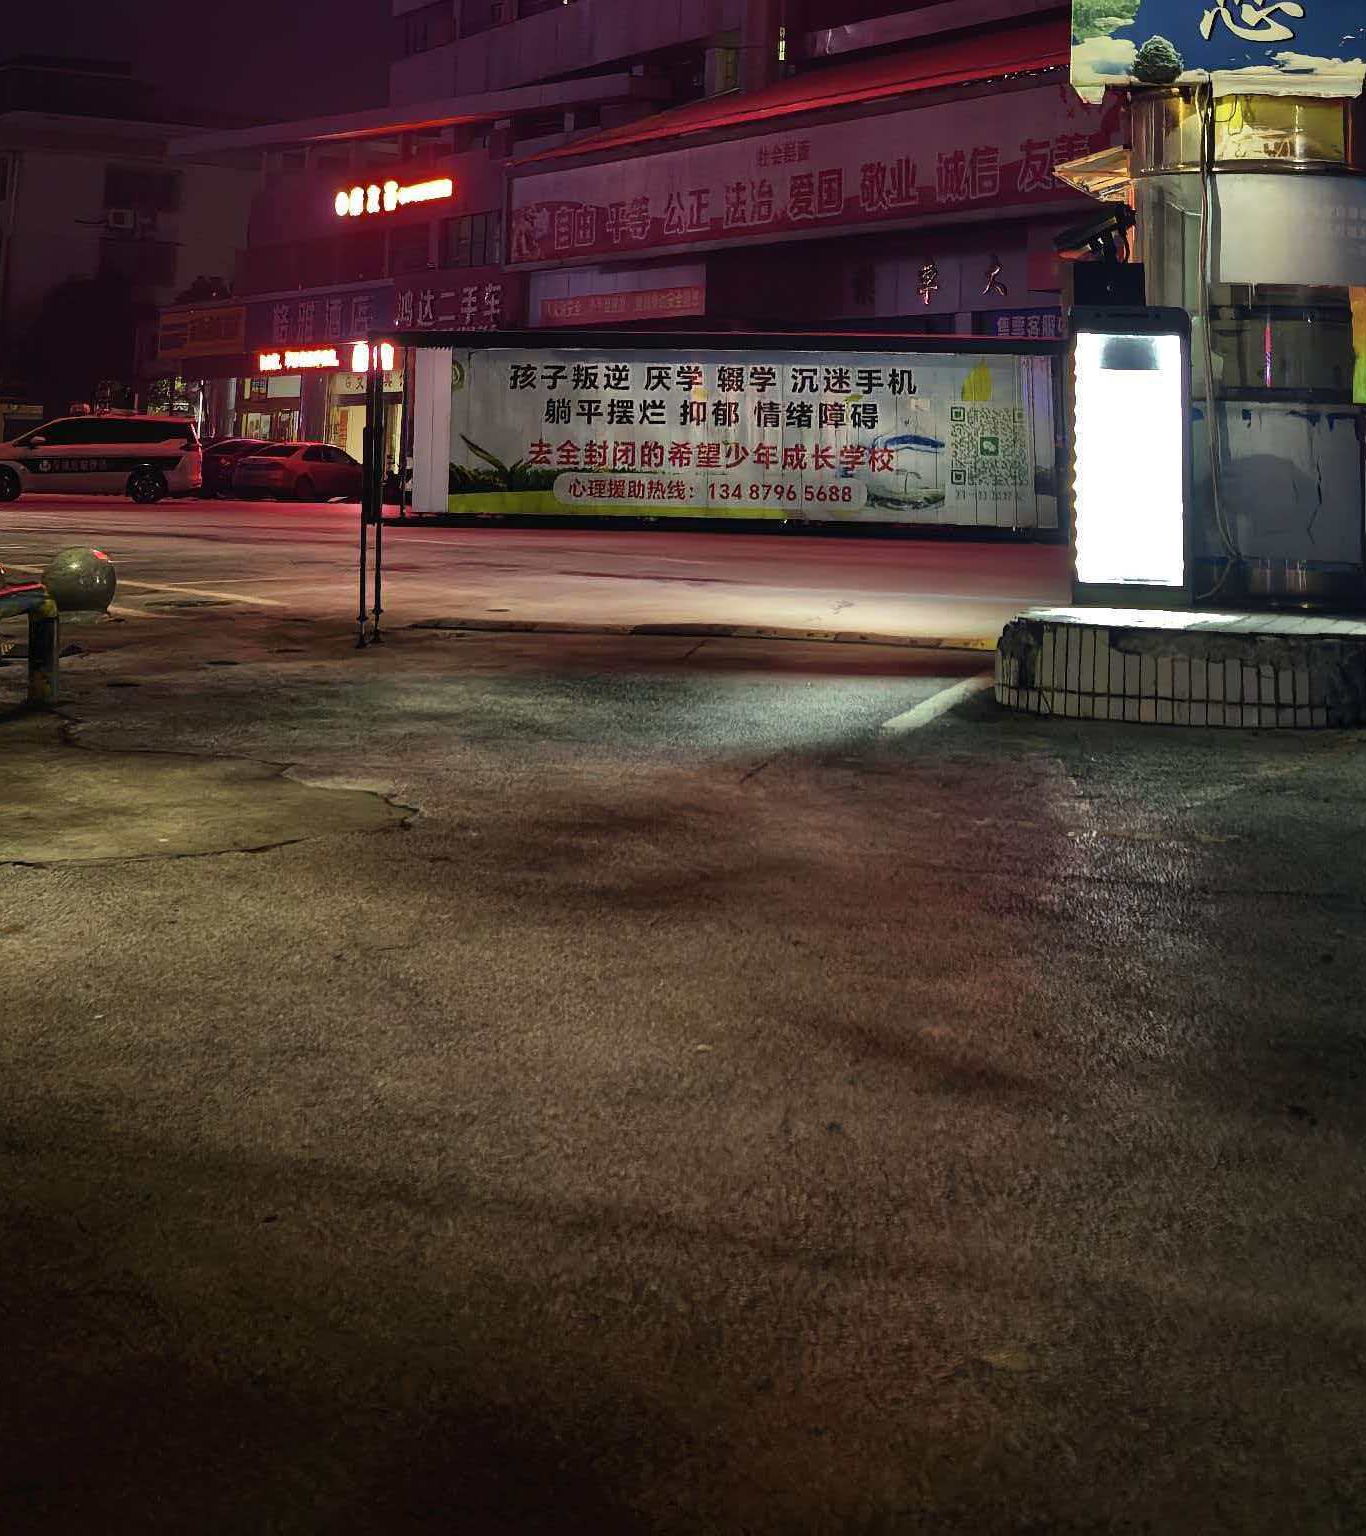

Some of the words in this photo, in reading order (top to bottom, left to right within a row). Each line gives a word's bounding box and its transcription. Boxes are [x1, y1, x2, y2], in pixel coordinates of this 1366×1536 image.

[554, 204, 597, 251] 自由
[605, 195, 651, 244] 平等
[663, 188, 711, 235] 公正
[723, 178, 775, 230] 法治
[788, 167, 844, 221] 爱国
[859, 156, 920, 212] 敬业
[937, 146, 1000, 208] 诚信
[509, 364, 631, 391] 孩子叛逆
[644, 365, 703, 392] 厌学
[717, 365, 777, 393] 辍学
[791, 366, 918, 395] 沉迷手机
[544, 398, 667, 426] 躺平摆烂
[679, 399, 739, 429] 抑郁
[753, 400, 879, 430] 情绪障碍
[528, 438, 895, 473] 去全封闭的希望少年成长学校
[708, 482, 742, 501] 134
[749, 483, 797, 502] 8796
[804, 484, 853, 503] 5688
